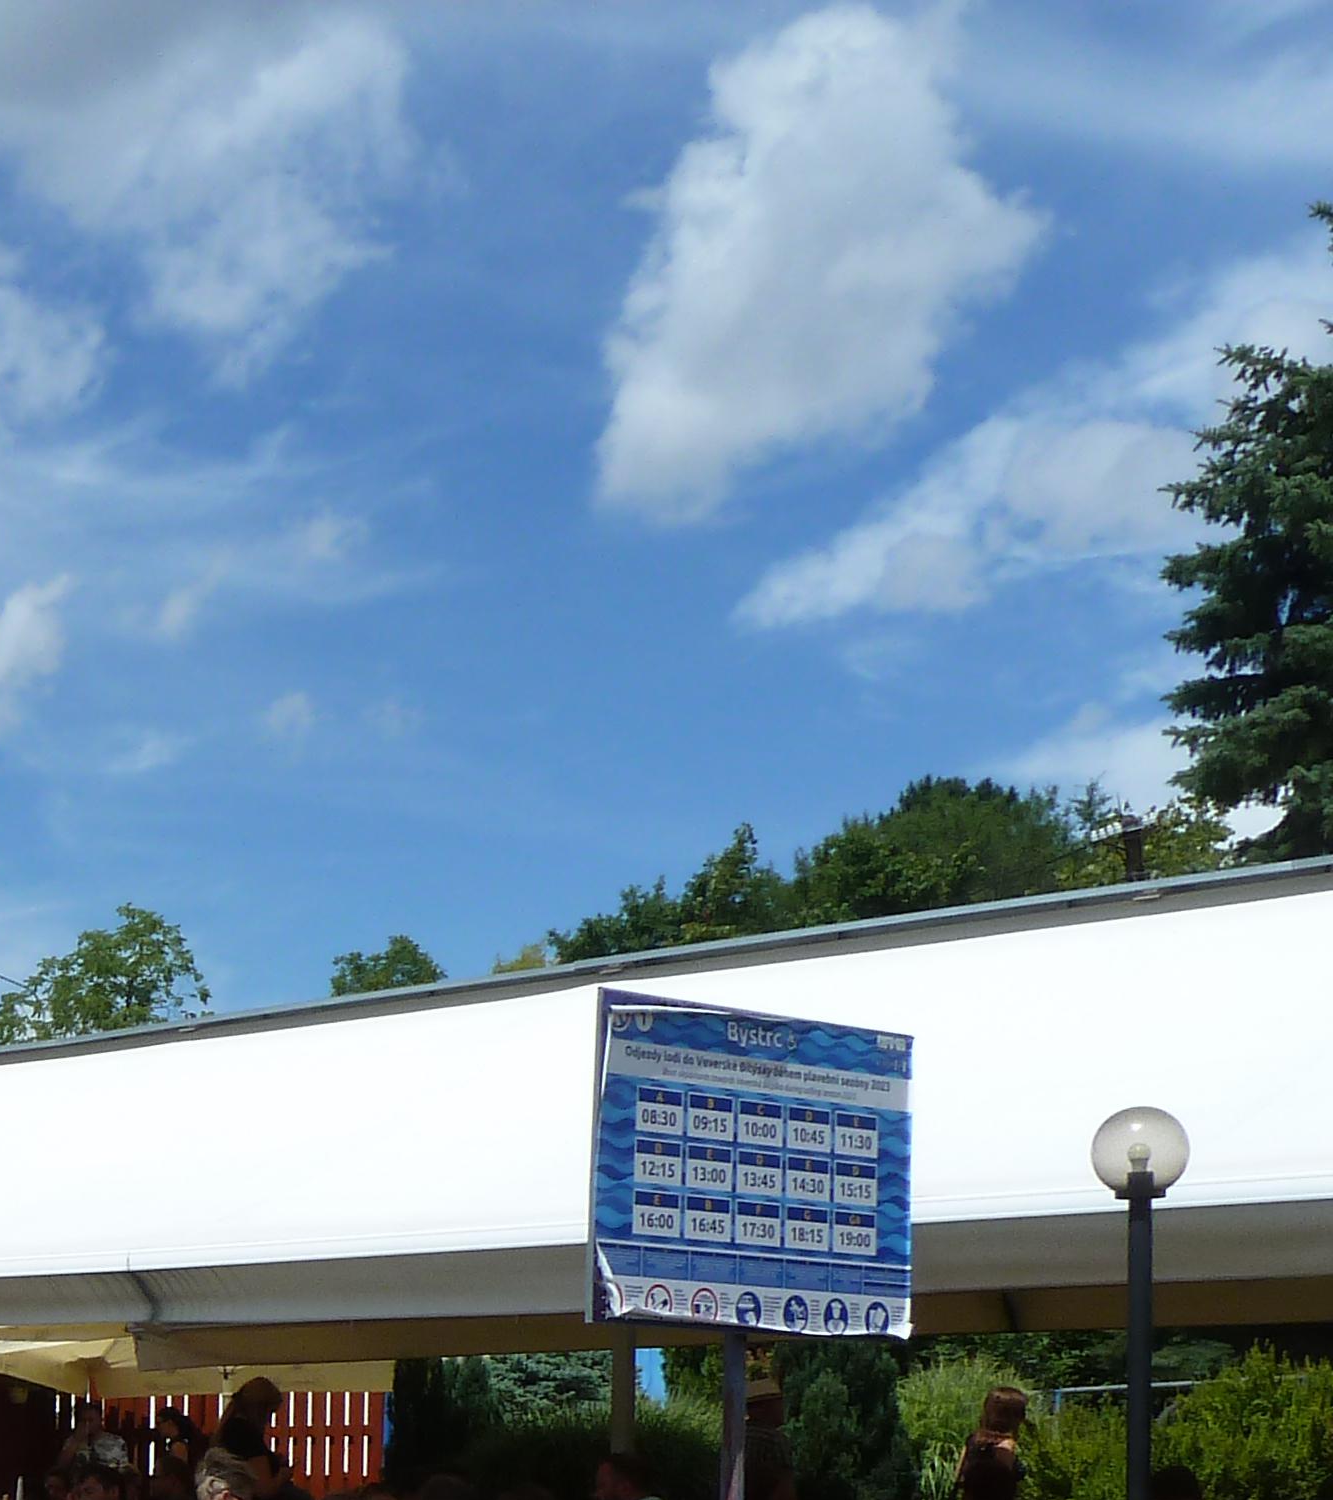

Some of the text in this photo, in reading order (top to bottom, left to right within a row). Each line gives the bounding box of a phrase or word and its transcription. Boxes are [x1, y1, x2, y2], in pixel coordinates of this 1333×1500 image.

[727, 1021, 783, 1049] Bystrc
[683, 1053, 694, 1066] do
[641, 1108, 677, 1127] 08:30
[693, 1115, 727, 1133] 09:15
[744, 1121, 777, 1139] 10:00
[793, 1127, 825, 1145] 10:45
[841, 1133, 872, 1150] 11:30
[641, 1160, 675, 1178] 12:15
[692, 1166, 726, 1184] 13:00
[743, 1171, 776, 1189] 13:45
[793, 1177, 824, 1194] 14:30
[840, 1182, 871, 1199] 15:15
[639, 1212, 674, 1229] 16:00
[691, 1217, 725, 1234] 16:45
[742, 1222, 775, 1239] 17:30
[791, 1227, 823, 1244] 18:15
[840, 1231, 871, 1248] 19:00
